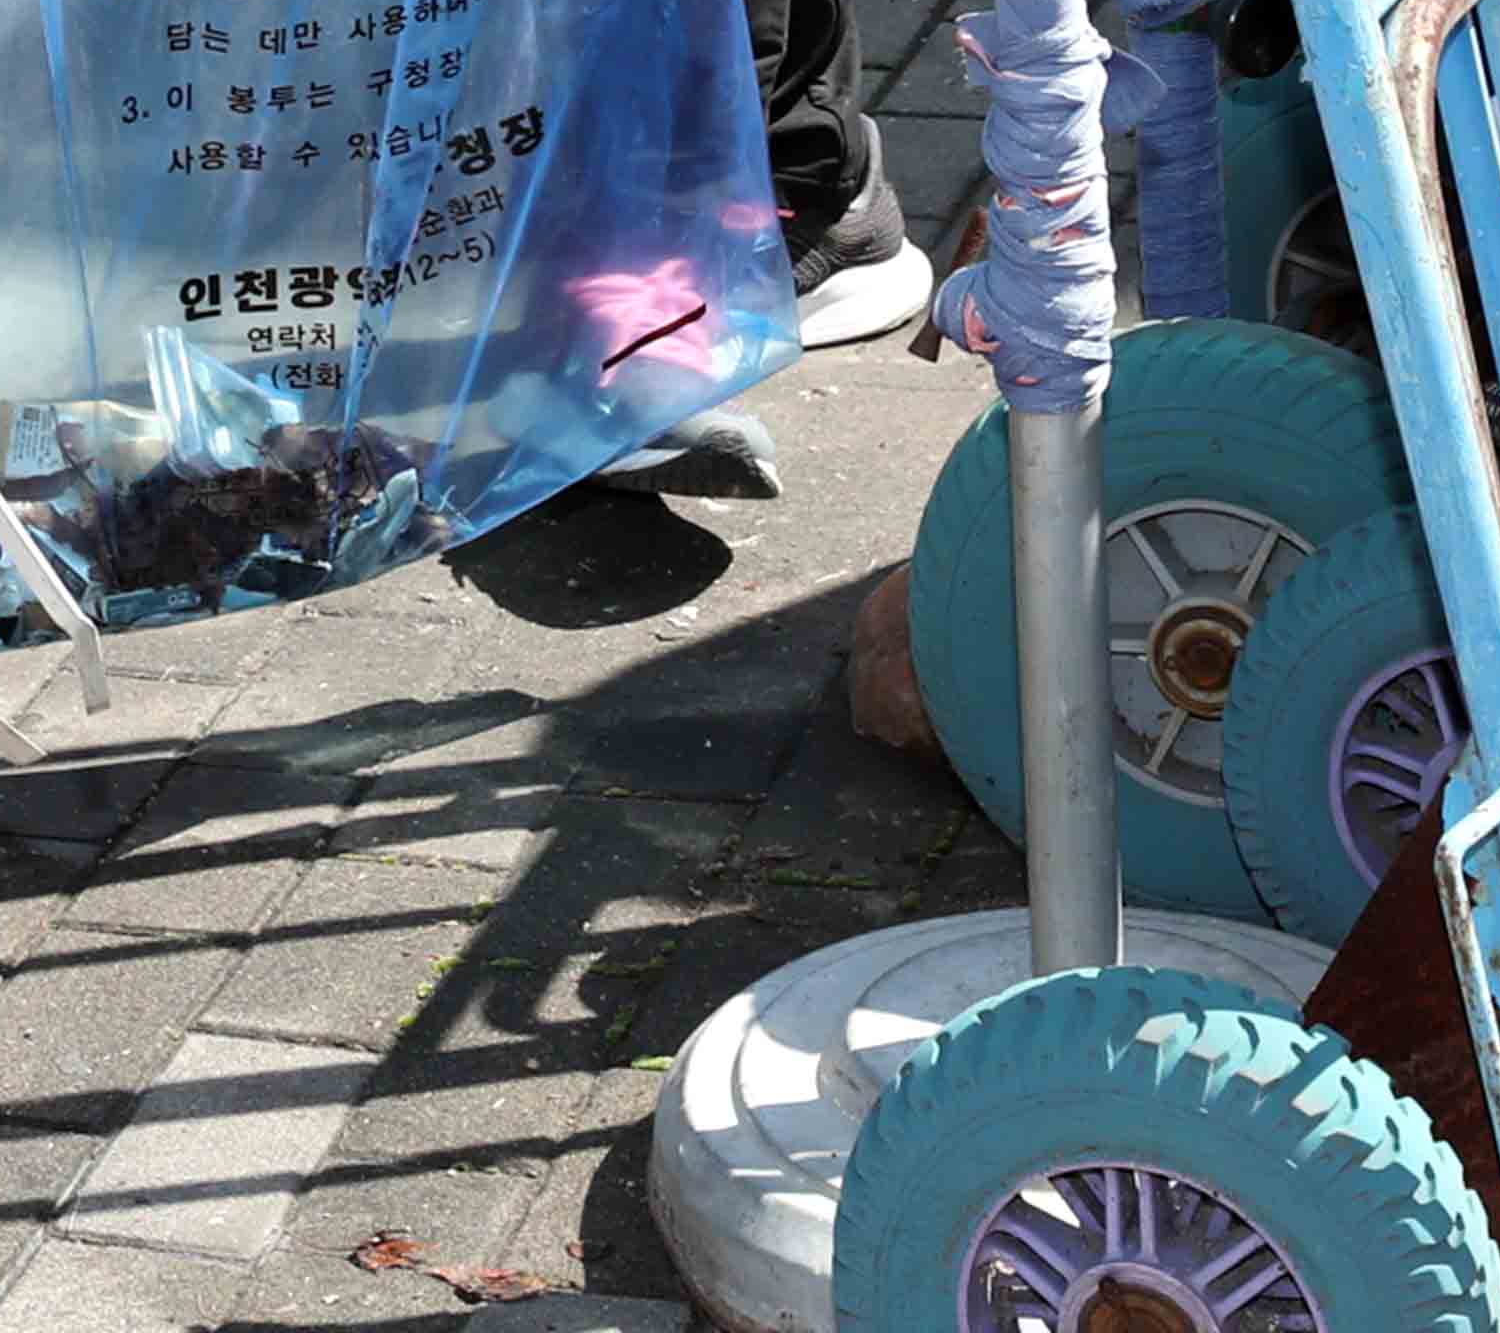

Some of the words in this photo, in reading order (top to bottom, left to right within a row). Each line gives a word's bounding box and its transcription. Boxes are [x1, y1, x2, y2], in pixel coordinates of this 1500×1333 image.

[166, 22, 232, 55] 담는
[258, 21, 325, 57] 데만
[120, 95, 151, 125] 3.
[166, 83, 194, 112] 이
[226, 80, 337, 115] 봉투는
[167, 140, 268, 176] 사용할
[291, 142, 322, 168] 수
[346, 109, 455, 163] 있습니
[247, 322, 337, 354] 연락처
